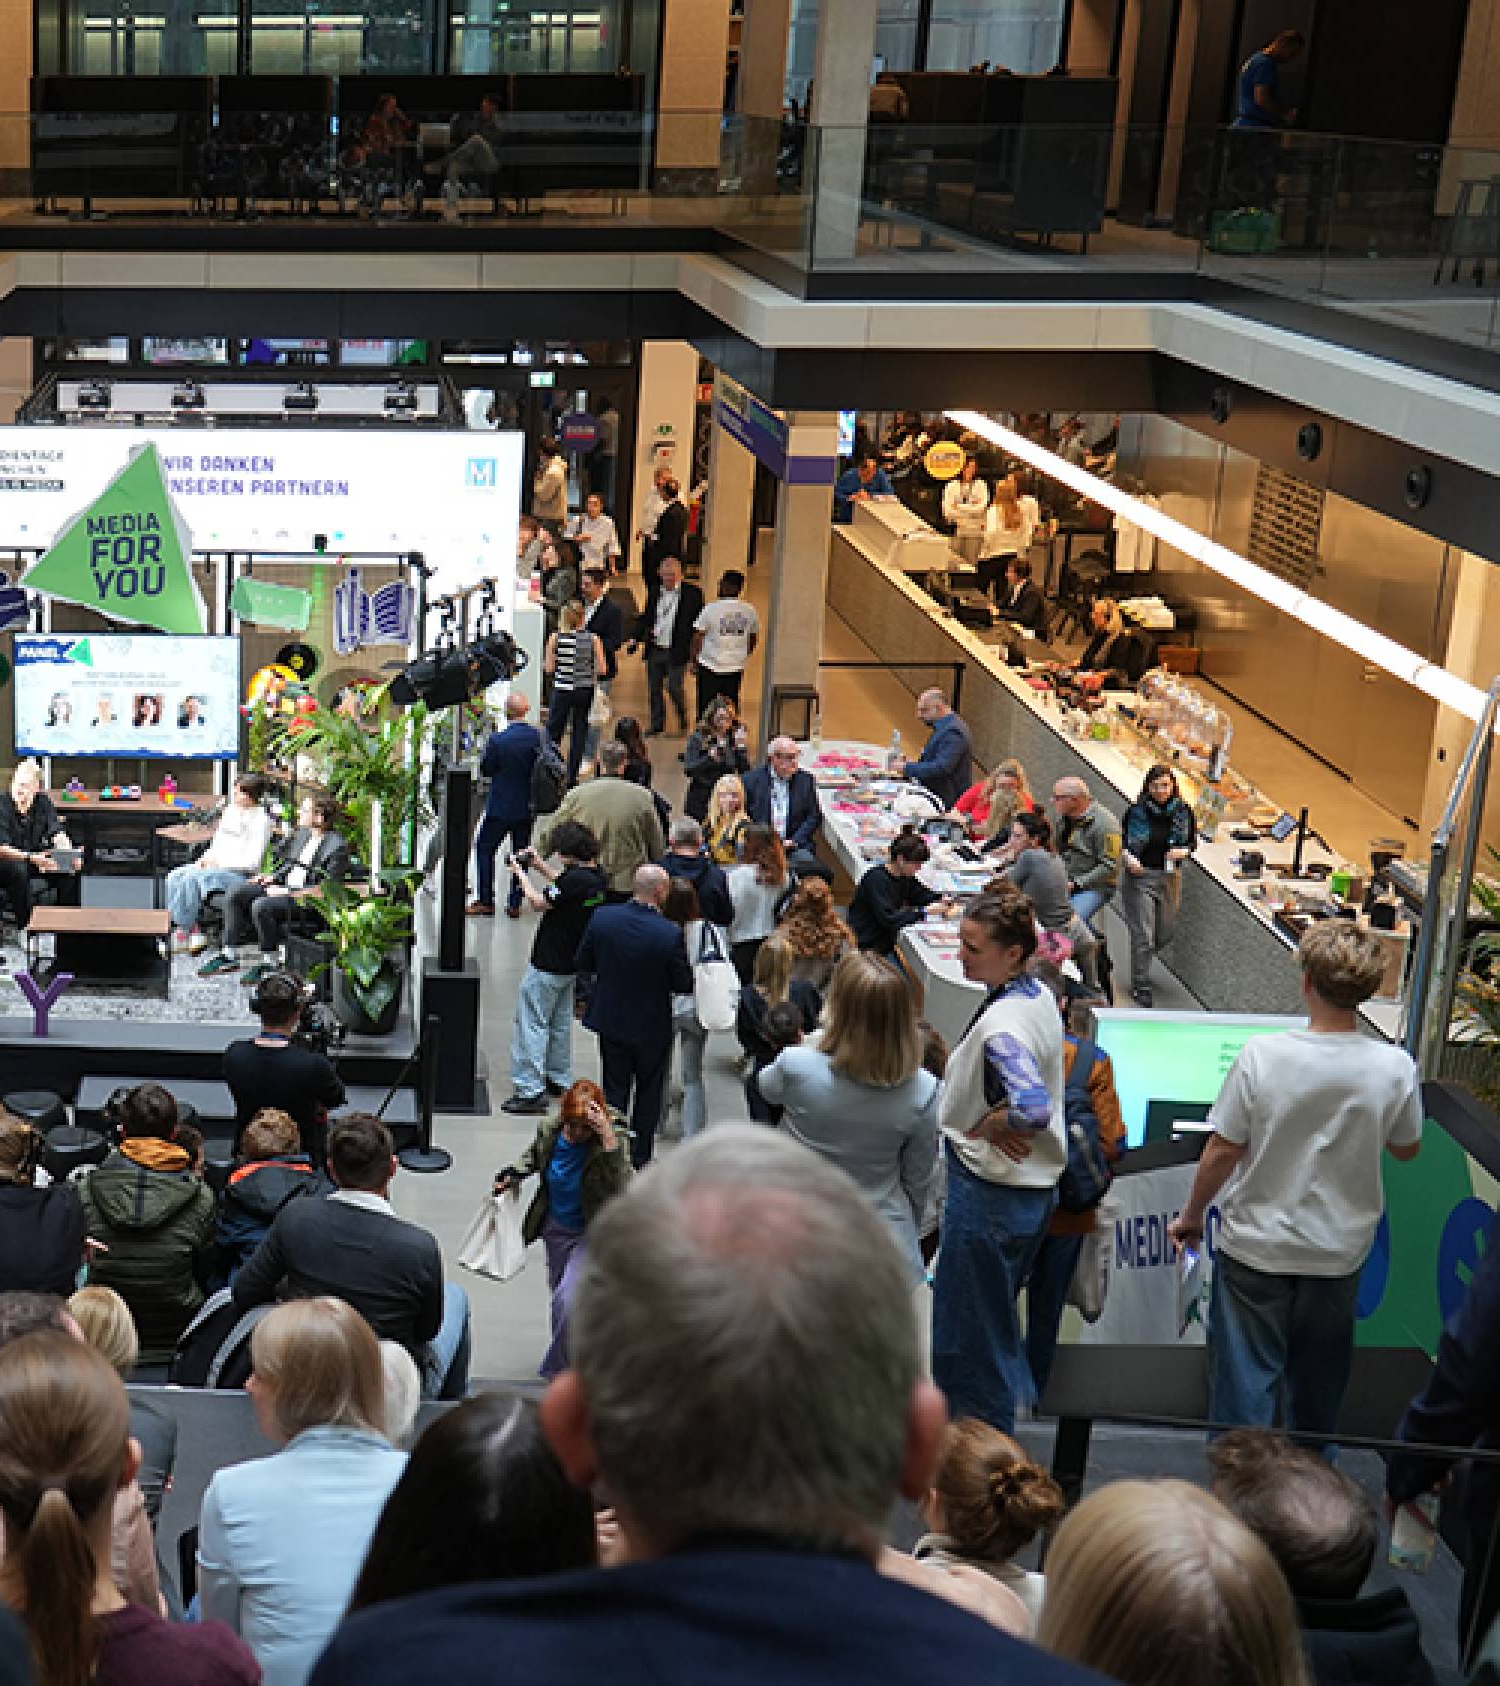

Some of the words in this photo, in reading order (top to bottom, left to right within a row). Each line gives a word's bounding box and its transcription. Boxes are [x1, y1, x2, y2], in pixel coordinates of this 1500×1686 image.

[200, 455, 275, 472] DANKEN
[167, 478, 244, 496] NSEREN
[251, 479, 349, 497] PARTNERN
[87, 512, 160, 535] MEDIA
[90, 533, 163, 568] FOR
[93, 566, 166, 598] YOU
